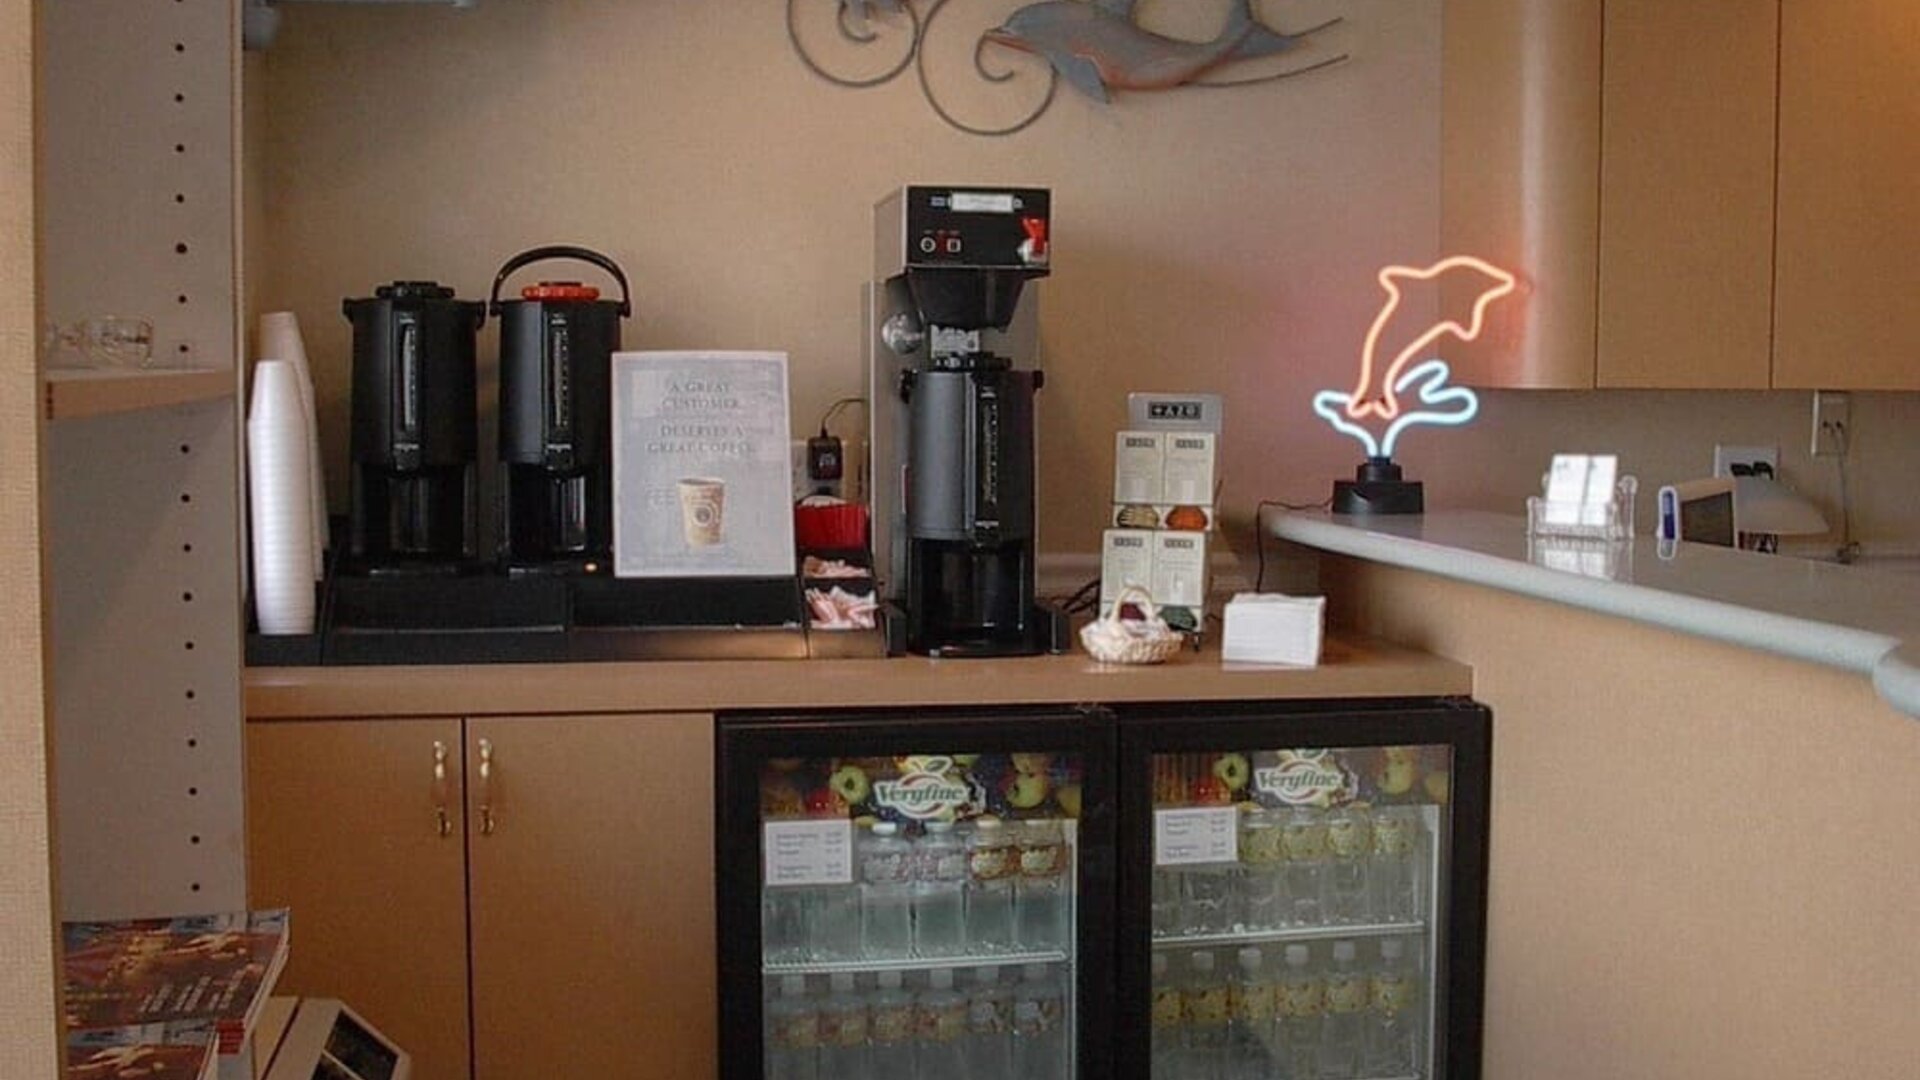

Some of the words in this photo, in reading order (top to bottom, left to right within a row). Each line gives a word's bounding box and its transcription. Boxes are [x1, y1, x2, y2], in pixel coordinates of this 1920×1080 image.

[684, 382, 729, 393] GREAT
[661, 398, 739, 409] CUSTOMER
[660, 425, 728, 437] DESERVES
[648, 442, 693, 454] GREAT
[1258, 770, 1338, 789] Veryfine
[877, 784, 964, 803] Veryfine
